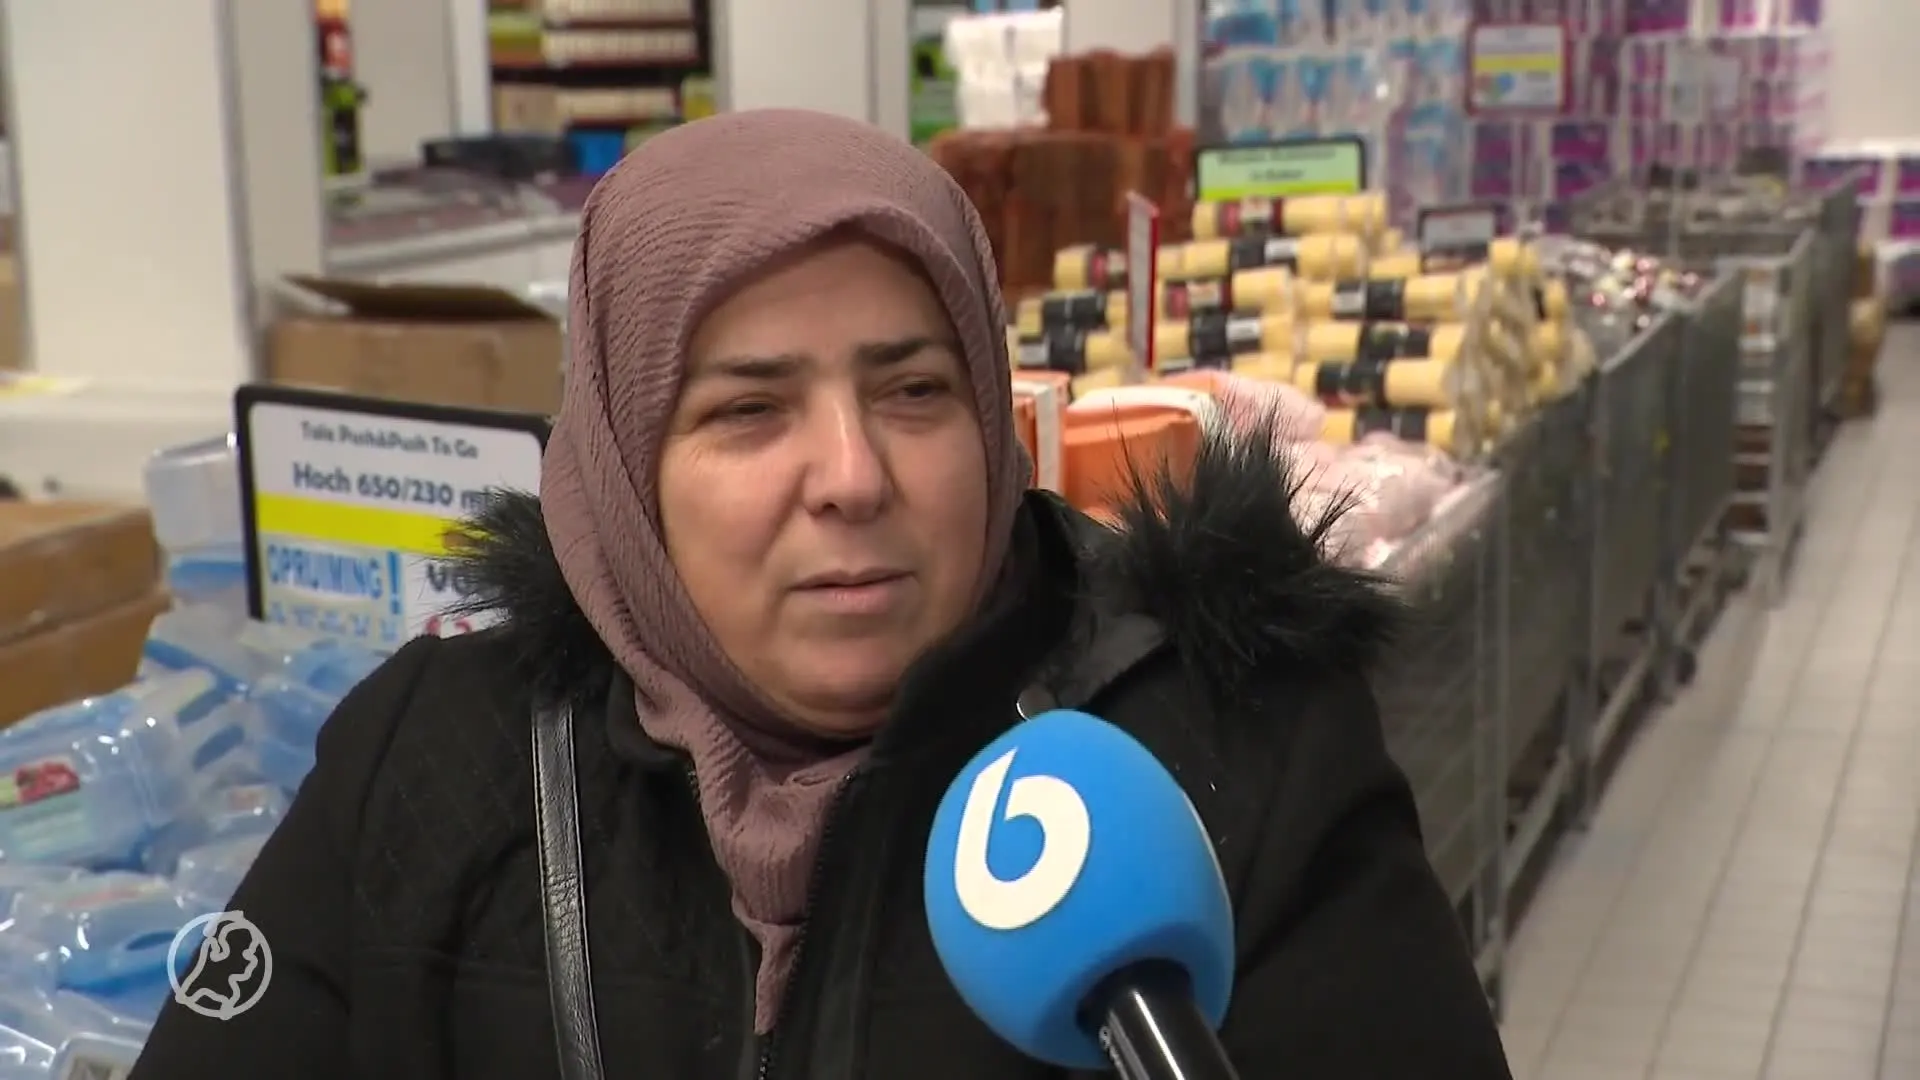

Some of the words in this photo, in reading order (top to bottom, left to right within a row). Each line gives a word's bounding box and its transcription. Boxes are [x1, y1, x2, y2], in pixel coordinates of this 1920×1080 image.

[431, 436, 451, 456] To
[455, 438, 479, 459] Go
[293, 462, 350, 493] Hoch
[357, 474, 453, 505] 650/230
[955, 747, 1090, 929] b
